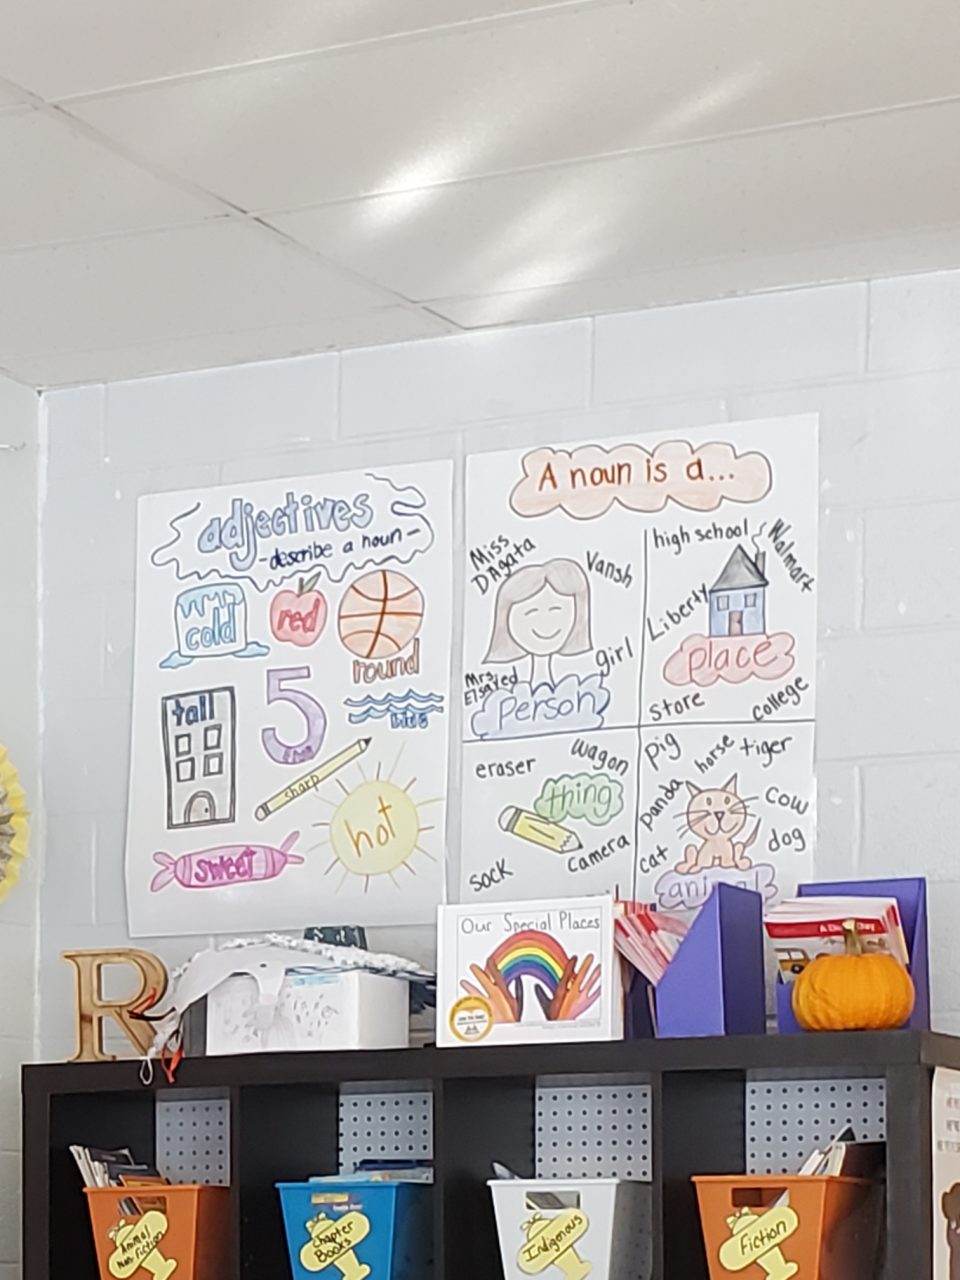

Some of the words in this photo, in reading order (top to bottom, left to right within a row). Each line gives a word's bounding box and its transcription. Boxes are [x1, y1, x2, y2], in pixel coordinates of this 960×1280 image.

[539, 463, 558, 492] A
[569, 461, 632, 489] noun
[646, 458, 668, 483] is
[198, 492, 374, 571] adjectives
[343, 541, 354, 553] a
[362, 529, 403, 550] noun
[652, 527, 691, 556] high
[697, 518, 749, 543] school
[469, 535, 510, 572] Miss
[586, 550, 634, 590] Vansh
[767, 518, 816, 594] Walmart
[185, 600, 238, 651] cold
[276, 598, 323, 634] red
[646, 582, 712, 642] Liberty
[352, 638, 421, 685] round
[595, 636, 634, 677] girl
[688, 640, 779, 684] place
[172, 690, 216, 727] tall
[261, 666, 328, 765] 5
[475, 755, 537, 779] eraser
[571, 737, 630, 778] wagon
[644, 732, 682, 771] pig
[695, 733, 736, 775] horse
[739, 736, 794, 768] tiger
[283, 773, 321, 802] sharp
[548, 781, 614, 823] thing
[640, 778, 685, 833] panda
[343, 795, 397, 858] hot
[768, 827, 806, 851] dog
[194, 846, 257, 882] sweet
[639, 844, 671, 876] cat
[461, 917, 493, 934] Our
[503, 912, 553, 934] Special
[558, 911, 602, 932] Places
[120, 1224, 152, 1257] Animal
[313, 1238, 352, 1263] Books
